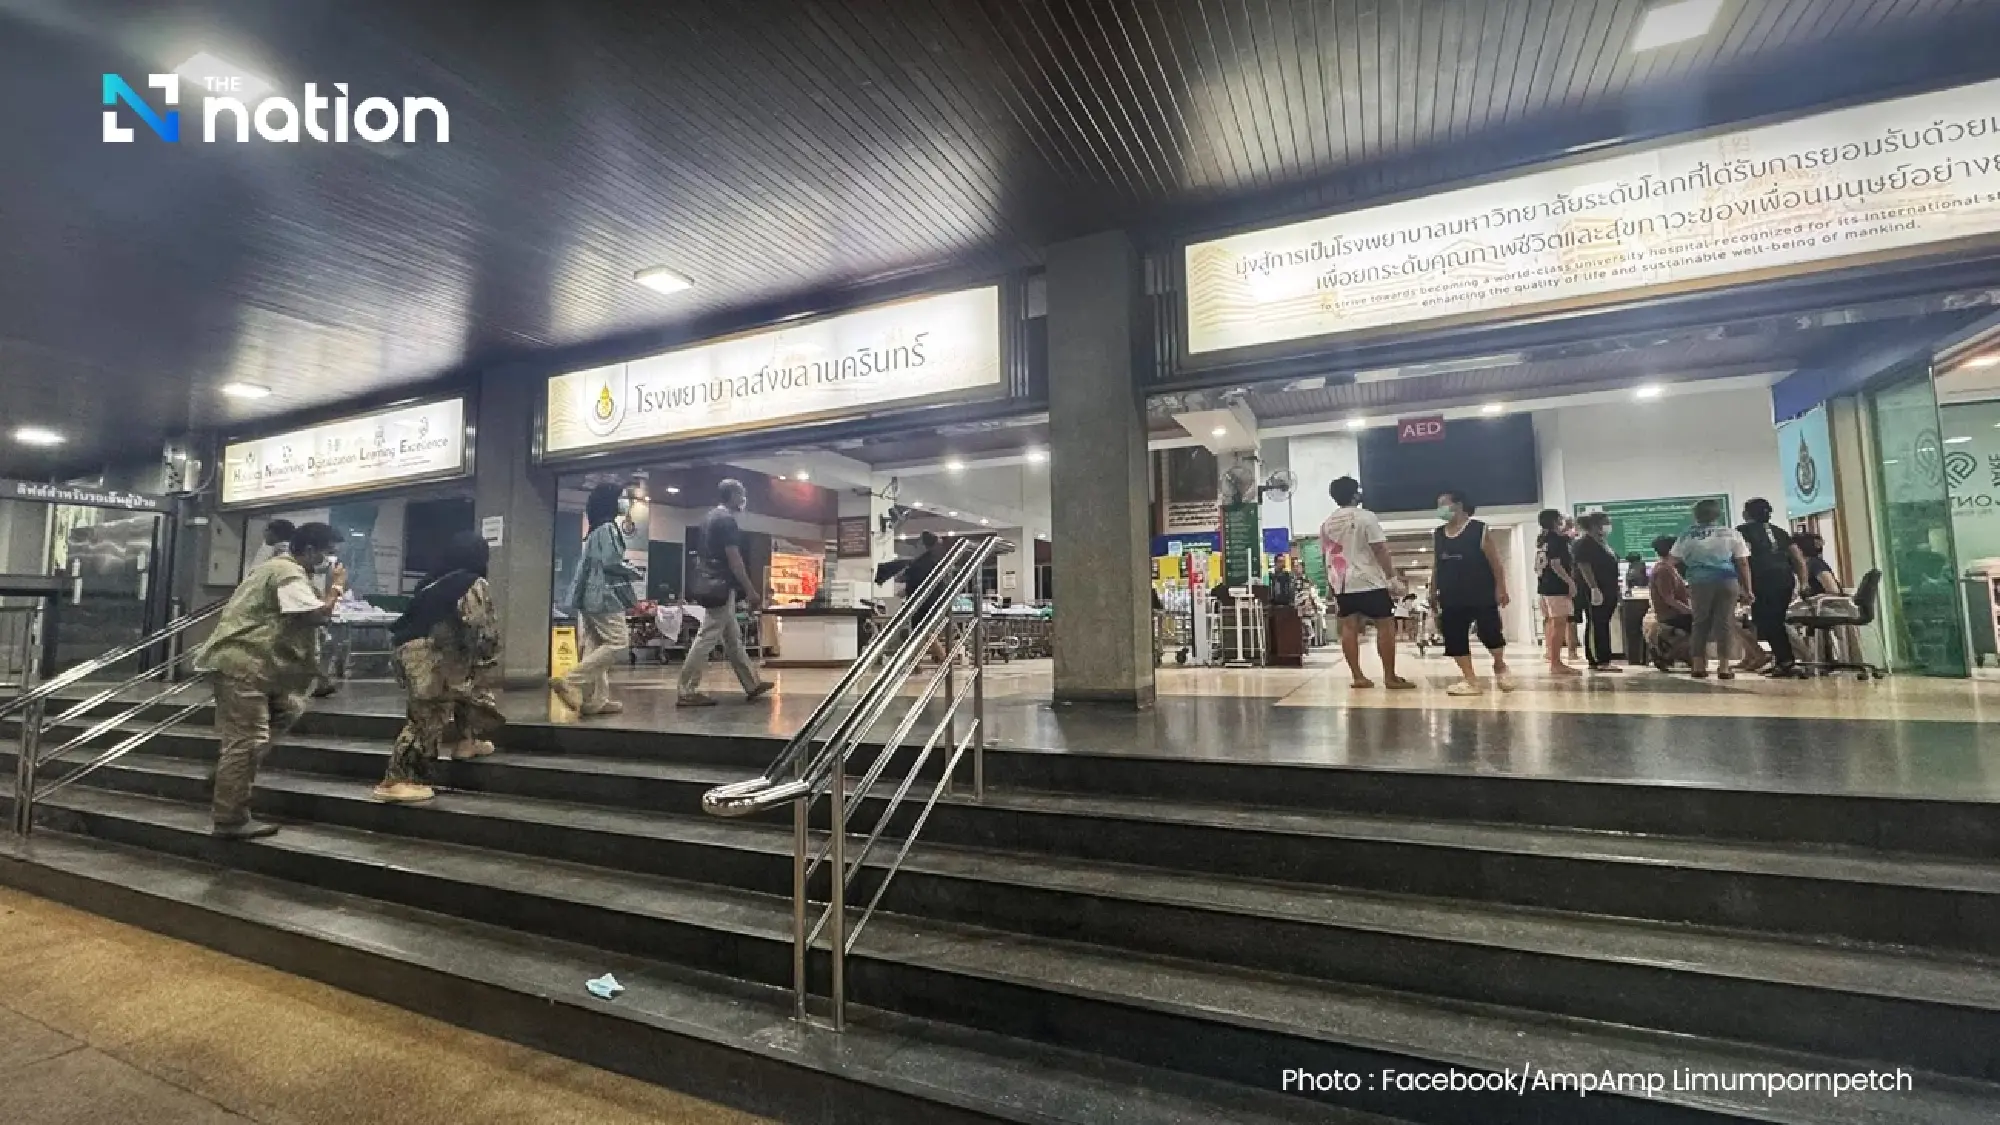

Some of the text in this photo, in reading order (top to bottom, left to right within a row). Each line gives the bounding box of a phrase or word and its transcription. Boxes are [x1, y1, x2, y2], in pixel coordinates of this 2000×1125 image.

[1371, 289, 1415, 304] towards
[1420, 278, 1479, 294] becoming
[1494, 265, 1571, 281] world-class
[1575, 250, 1644, 269] university
[1649, 239, 1707, 256] hospital
[1714, 224, 1803, 247] recognized
[1808, 219, 1832, 232] for
[1837, 214, 1859, 227] its
[1422, 219, 1921, 307] enhancing the quality of life and sustainable well-being of mankind.
[635, 331, 929, 413] โรงพยาบาลสงขลานครินทร์
[1403, 421, 1441, 438] AED
